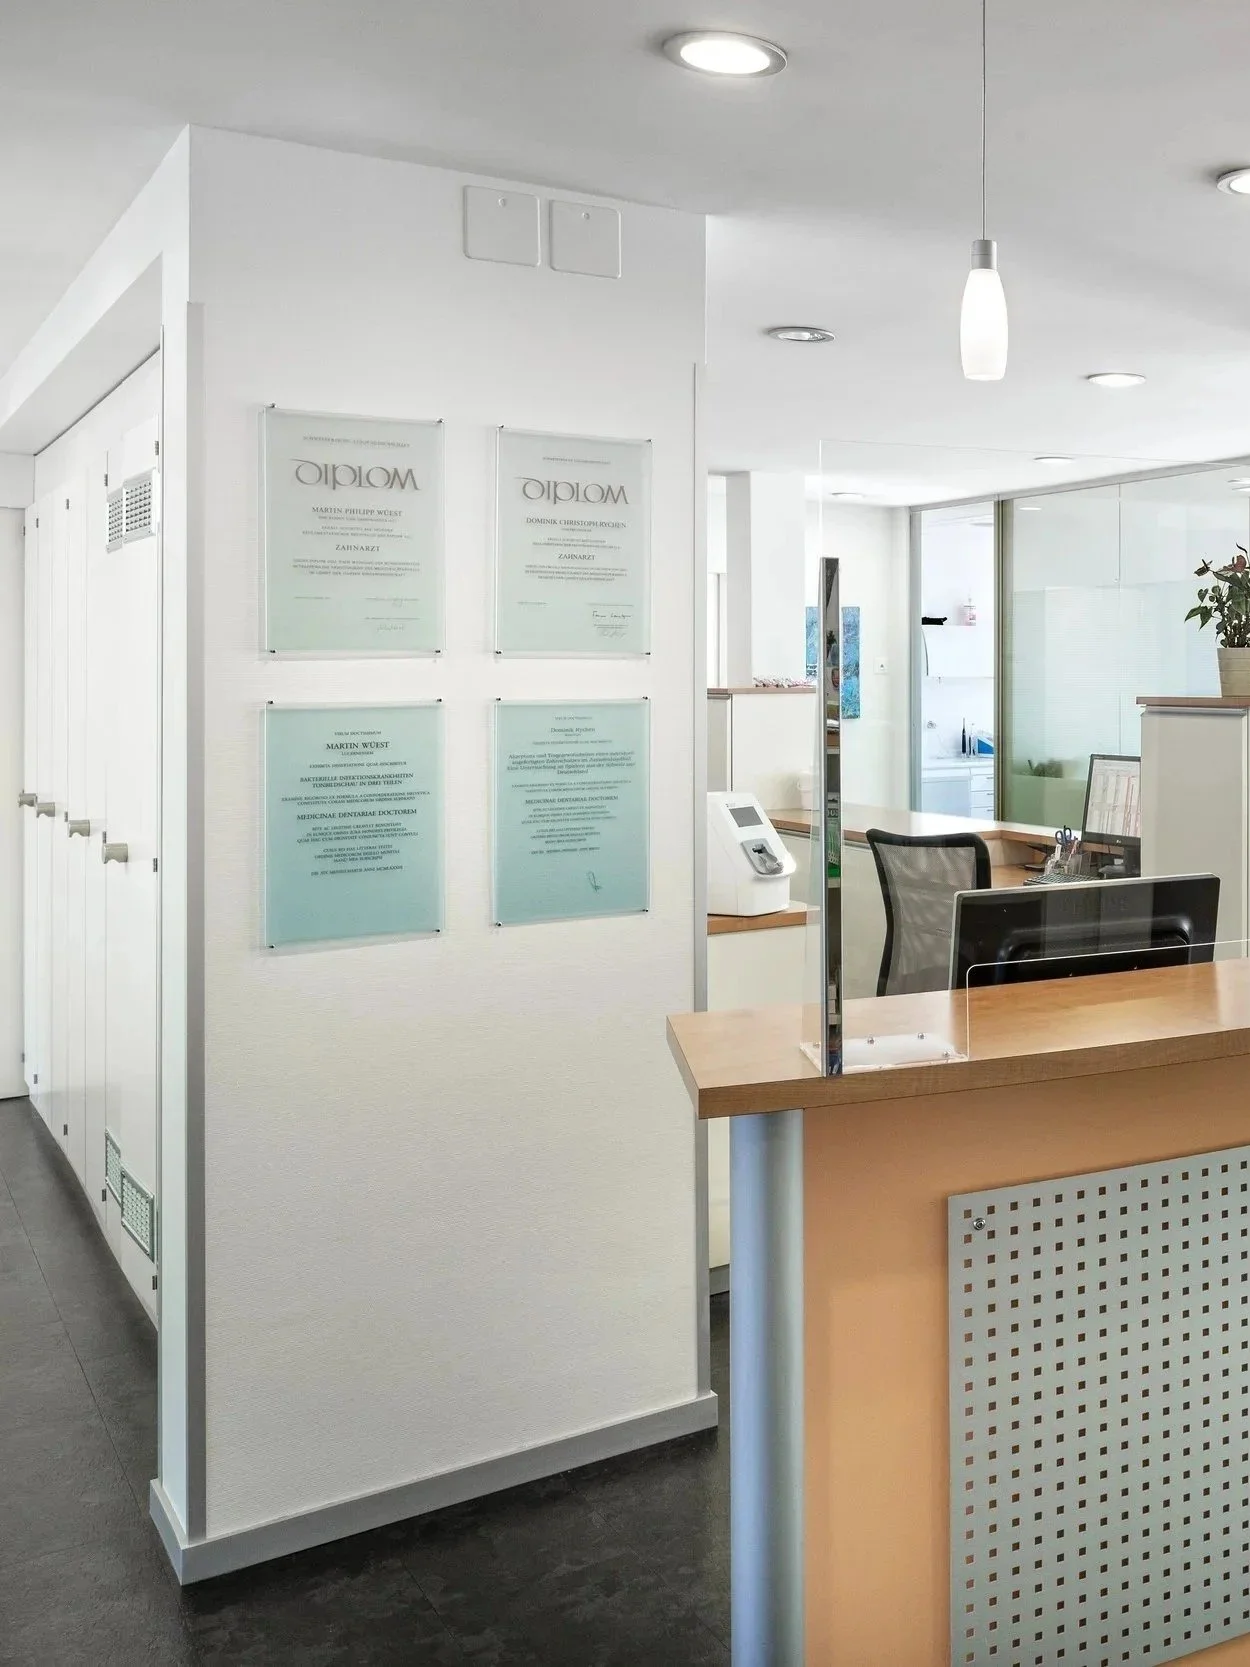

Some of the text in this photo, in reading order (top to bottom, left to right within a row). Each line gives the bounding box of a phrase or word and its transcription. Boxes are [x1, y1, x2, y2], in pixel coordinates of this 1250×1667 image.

[312, 506, 343, 514] MARTIN
[345, 508, 375, 516] PHILIPP
[526, 517, 627, 528] DOMINIK CHRISTOPH RYCHEN
[335, 544, 380, 552] ZAHNARZT
[326, 740, 390, 750] MARTIN WÜEST
[296, 808, 417, 820] MEDICINAE DENTARIAE DOCTOREM
